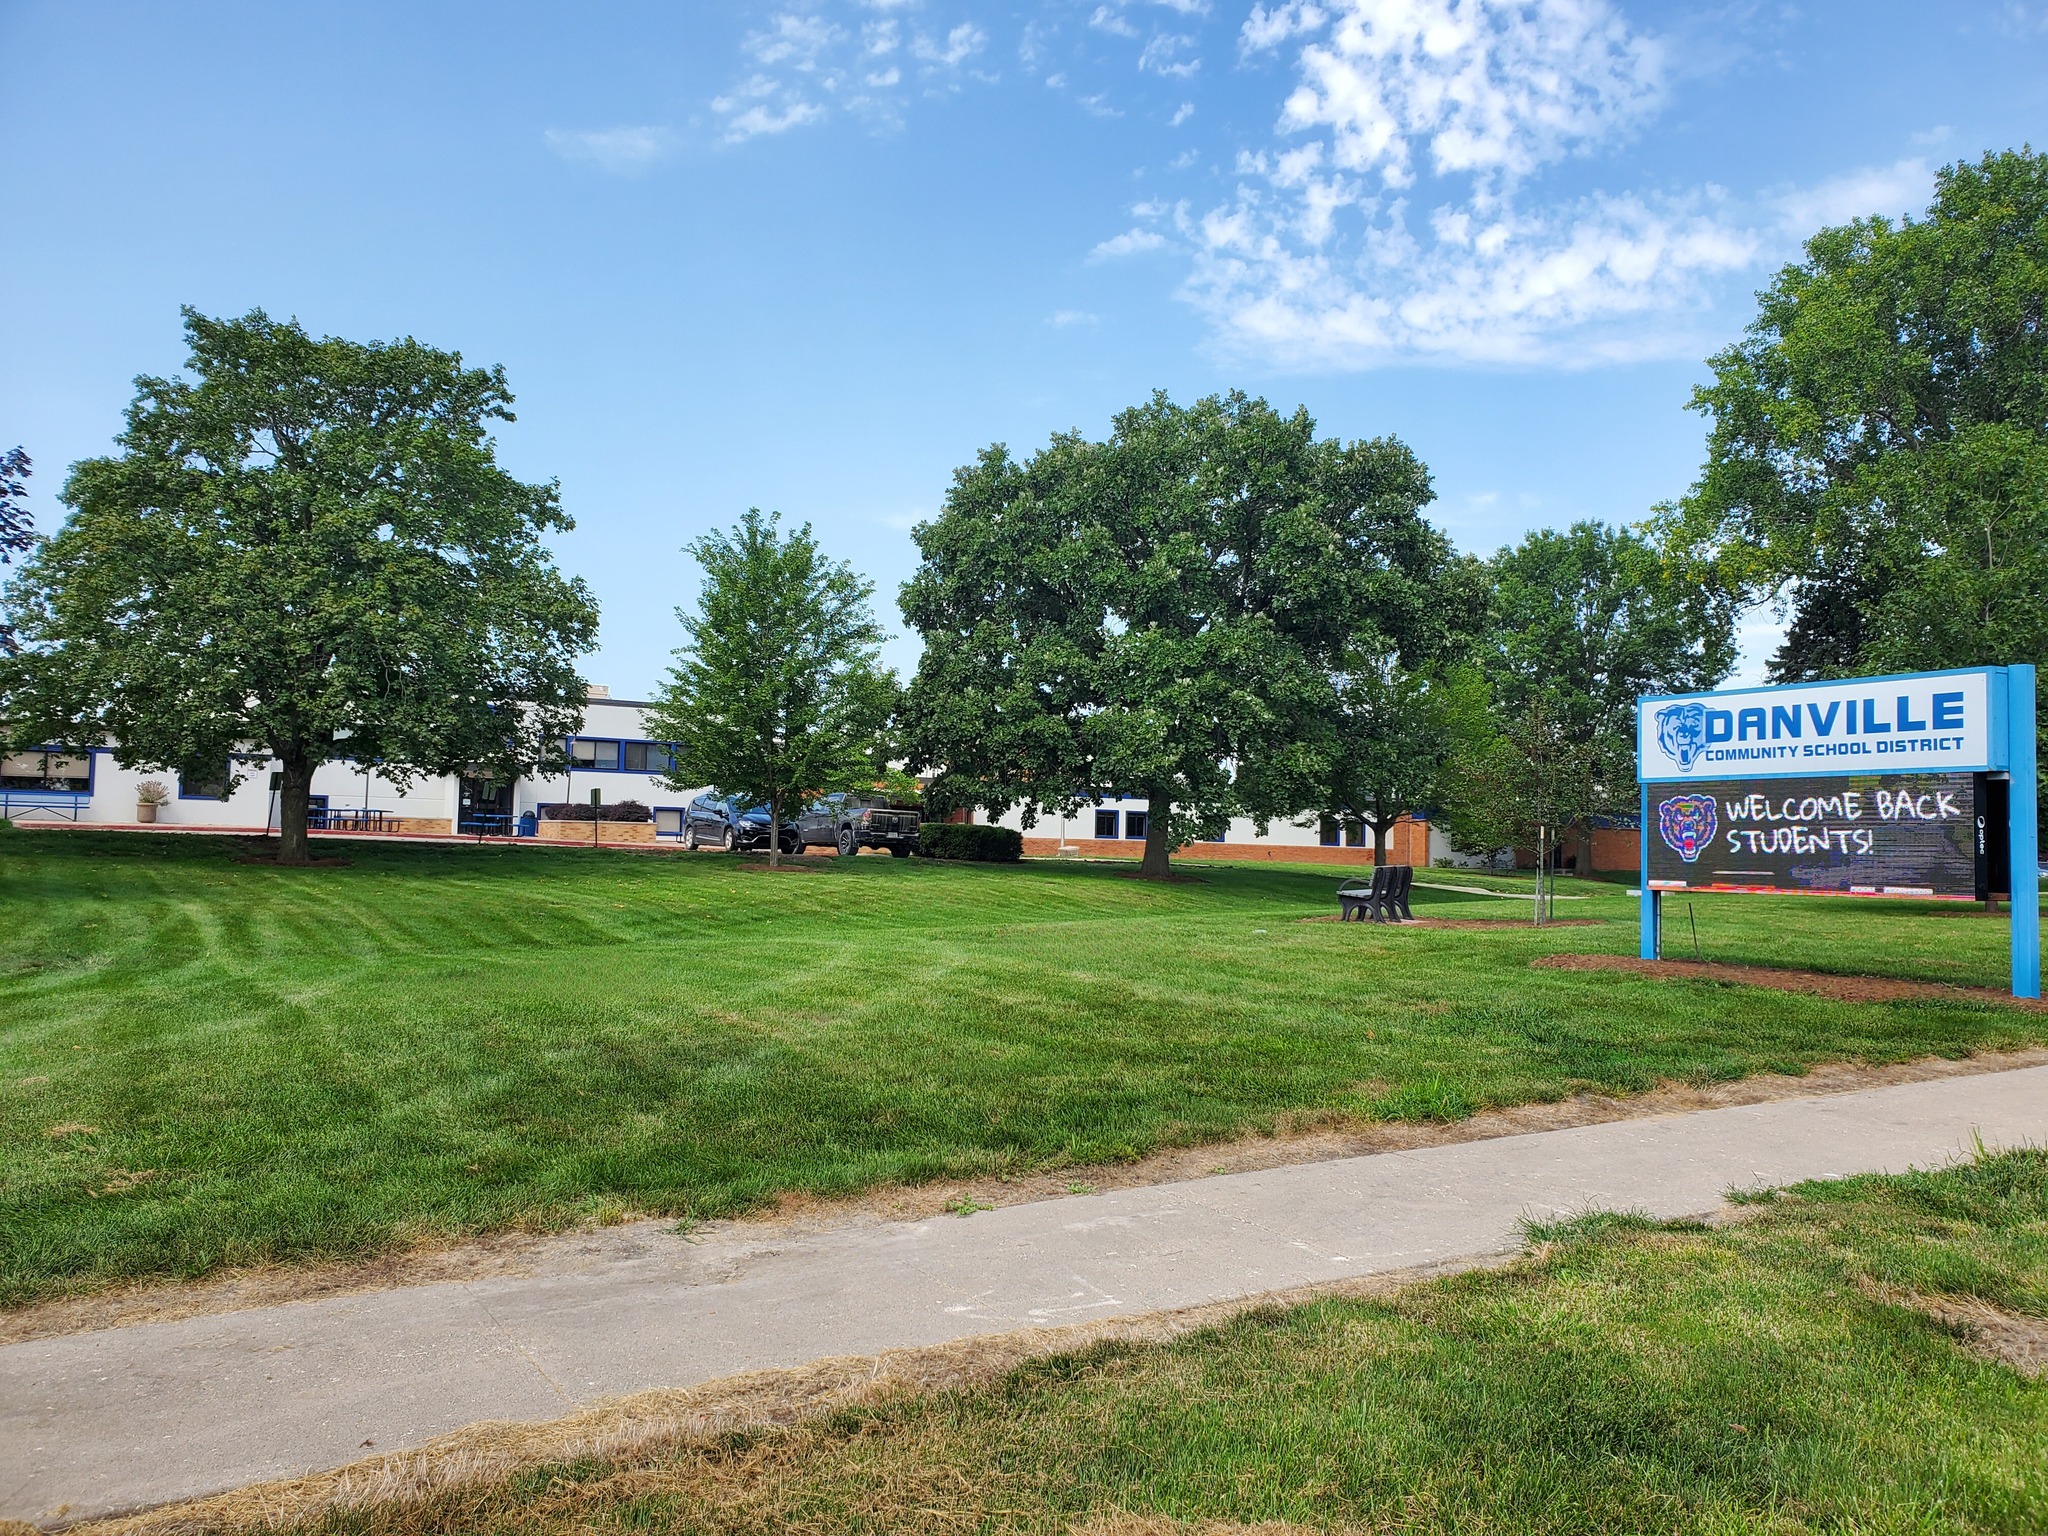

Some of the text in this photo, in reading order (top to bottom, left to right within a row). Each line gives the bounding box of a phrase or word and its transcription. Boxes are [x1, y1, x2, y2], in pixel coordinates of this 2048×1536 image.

[1705, 691, 1964, 743] DANVILLE
[1705, 736, 1965, 762] COMMUNITY SCHOOL DISTRICT
[1725, 789, 1961, 821] WELCOME BACK
[1726, 826, 1874, 855] STUDENTS!
